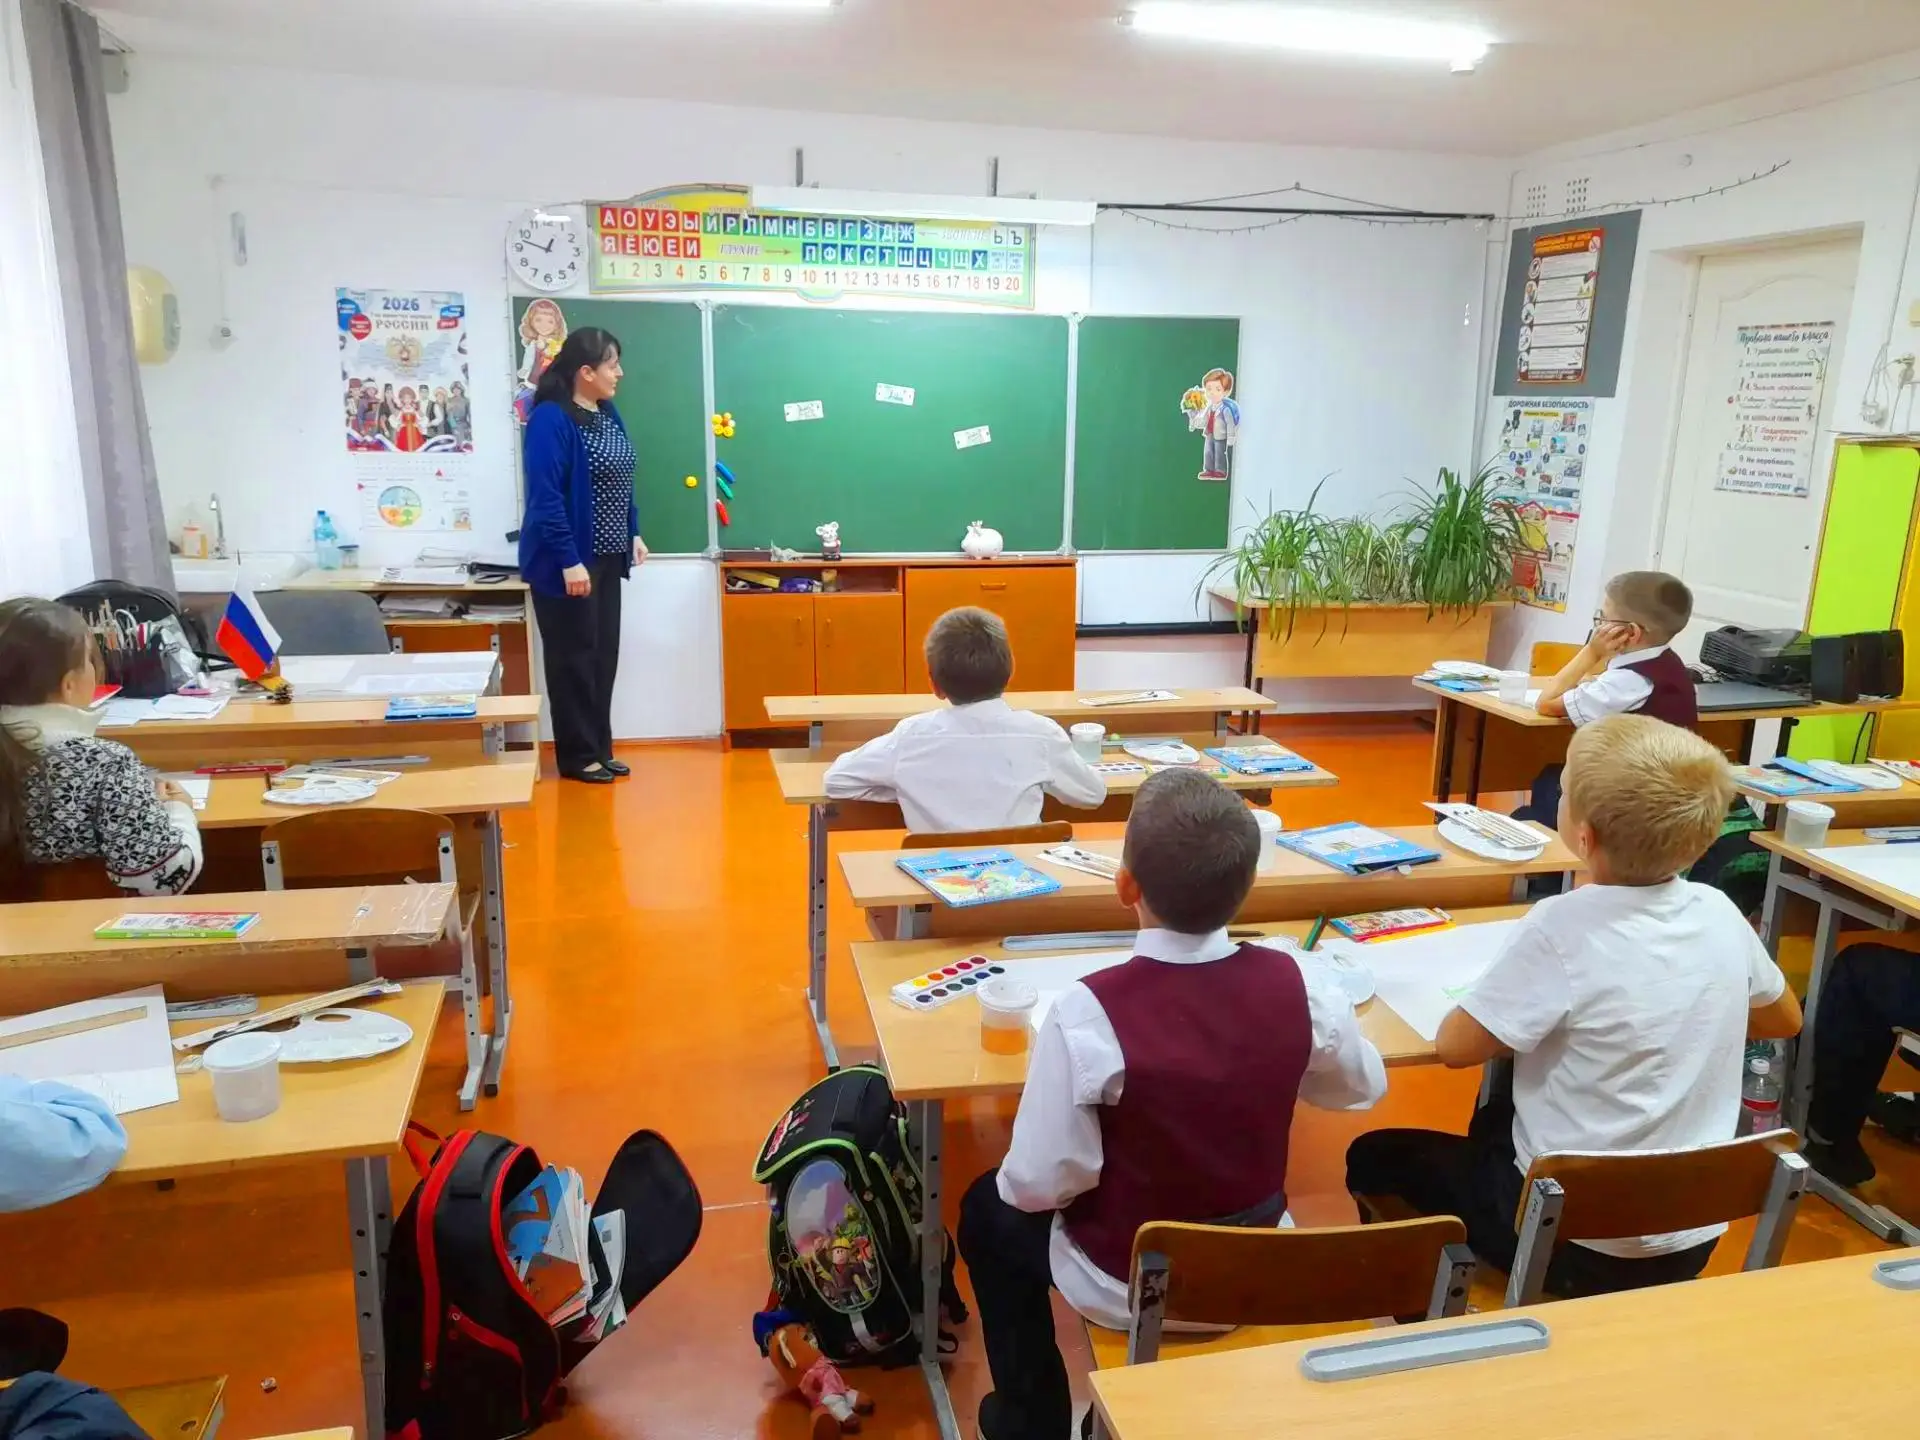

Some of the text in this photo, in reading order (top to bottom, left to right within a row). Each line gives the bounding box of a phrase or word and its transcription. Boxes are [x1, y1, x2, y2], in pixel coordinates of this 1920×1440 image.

[519, 229, 532, 239] 10
[568, 233, 576, 243] 2
[514, 242, 524, 252] 9
[572, 247, 580, 257] 3
[520, 257, 528, 267] 8
[568, 262, 576, 271] 4
[530, 268, 538, 277] 7
[558, 270, 566, 280] 5
[610, 262, 1020, 290] 1 2 3 4 5 6 7 8 9 10 11 12 13 14 15 16 17 18 19 20
[544, 273, 552, 283] 6
[382, 297, 420, 311] 2026
[376, 320, 429, 330] РОССИИ
[1508, 400, 1589, 408] ДОРОЖНАЯ БЕЗОПАСНОСТЬ
